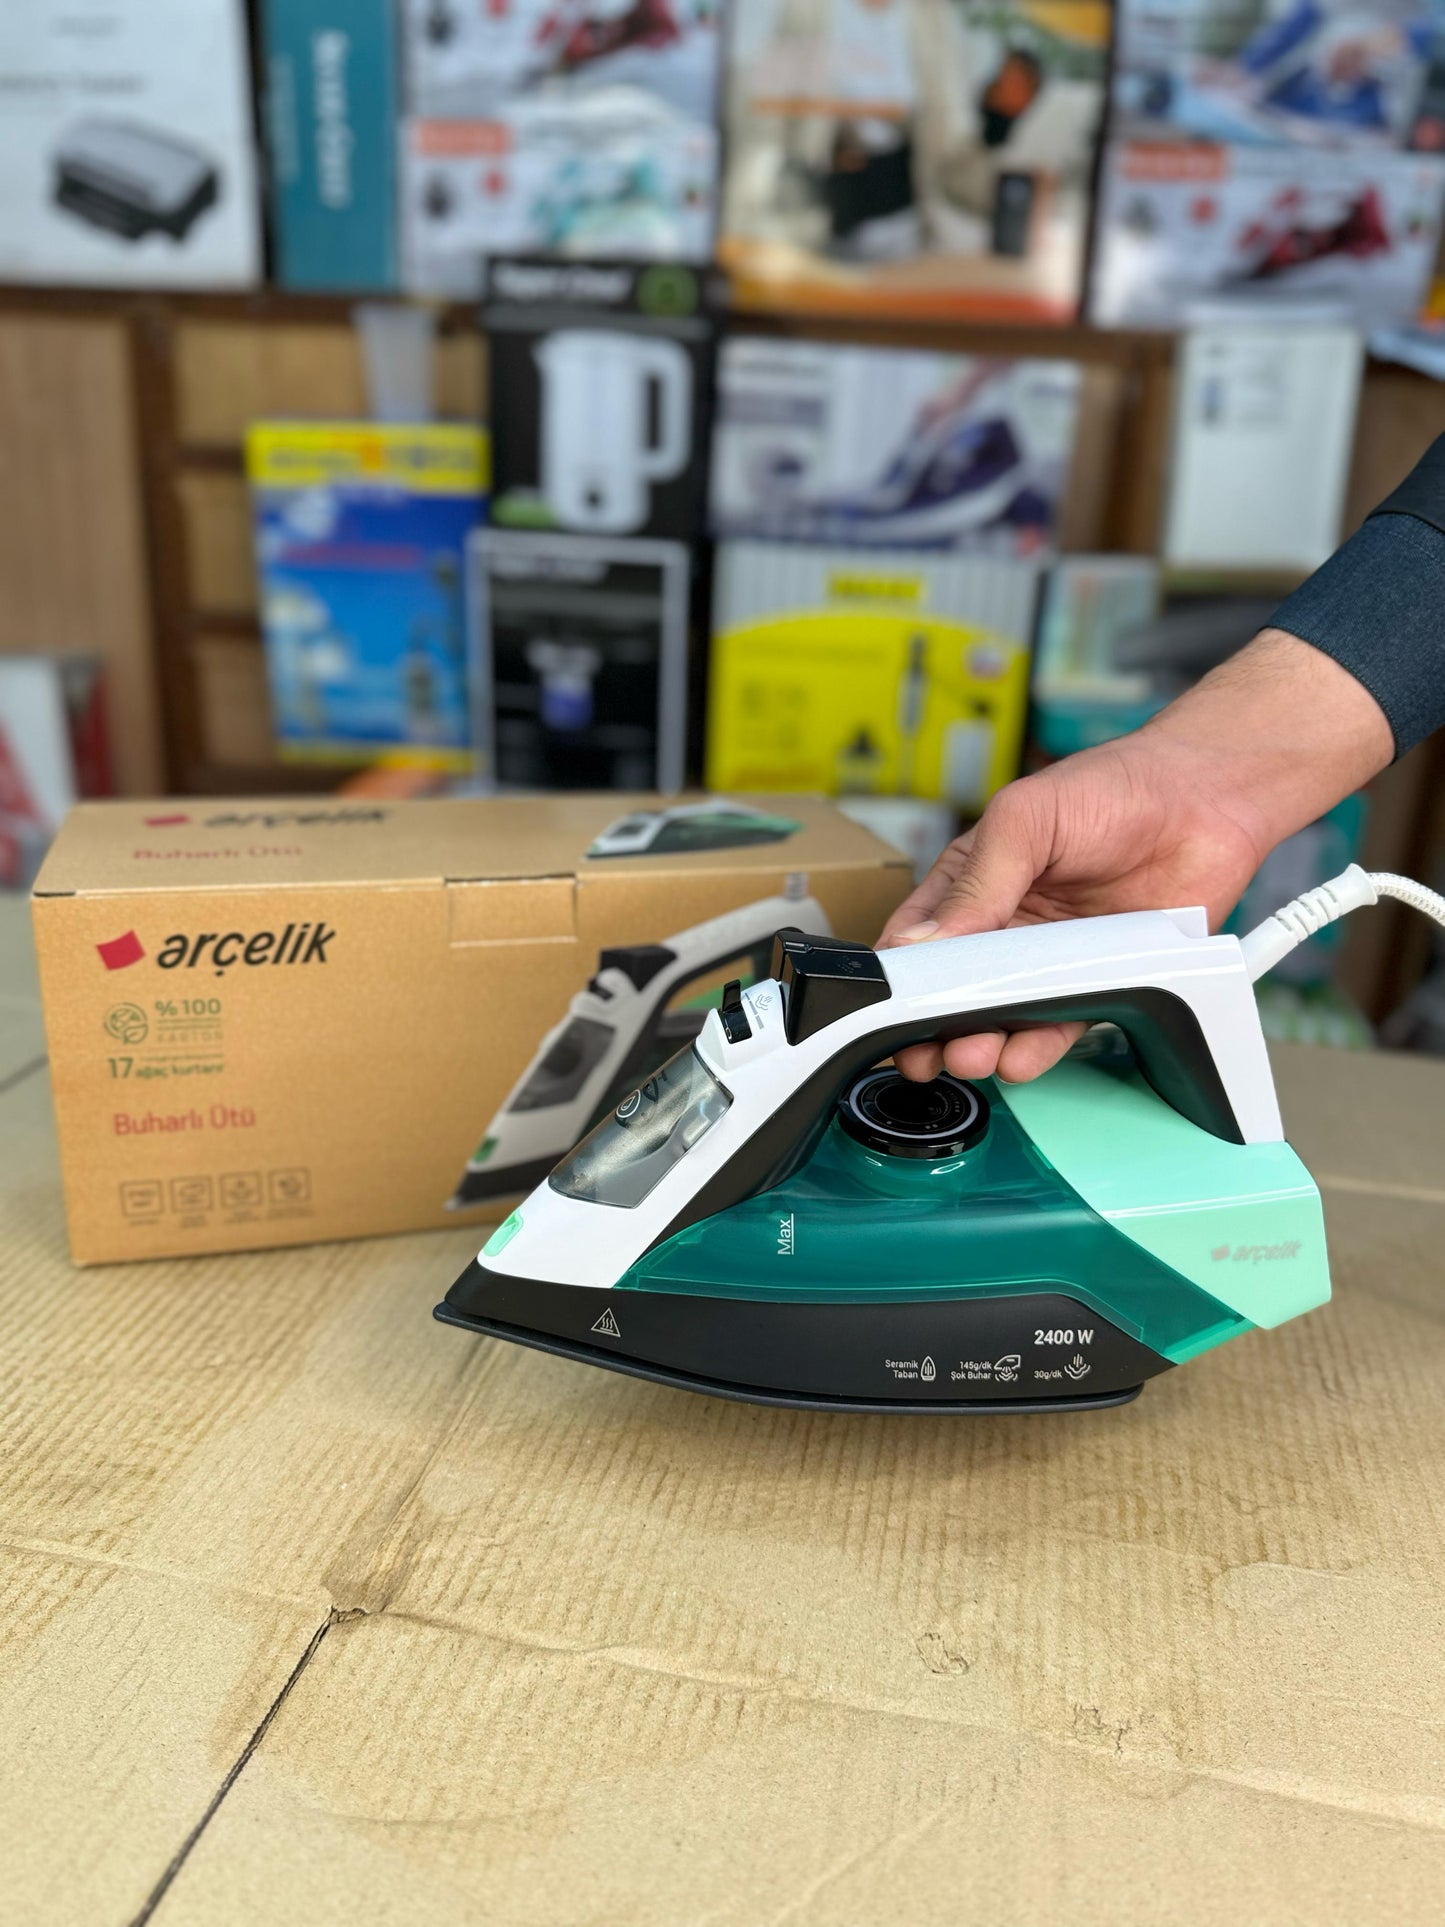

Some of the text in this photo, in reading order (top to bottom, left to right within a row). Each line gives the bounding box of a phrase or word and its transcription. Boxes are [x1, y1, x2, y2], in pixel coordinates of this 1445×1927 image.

[156, 922, 336, 977] arçelik
[108, 1056, 134, 1079] 17
[113, 1101, 256, 1136] Buharlı Ütü
[777, 1219, 791, 1255] Max
[1033, 1329, 1094, 1345] 2400 W
[885, 1359, 919, 1369] Seramik
[959, 1361, 993, 1372] 145g/dk
[893, 1369, 919, 1379] Taban
[950, 1370, 992, 1381] Şok Buhar
[1033, 1370, 1063, 1380] 30g/dk
